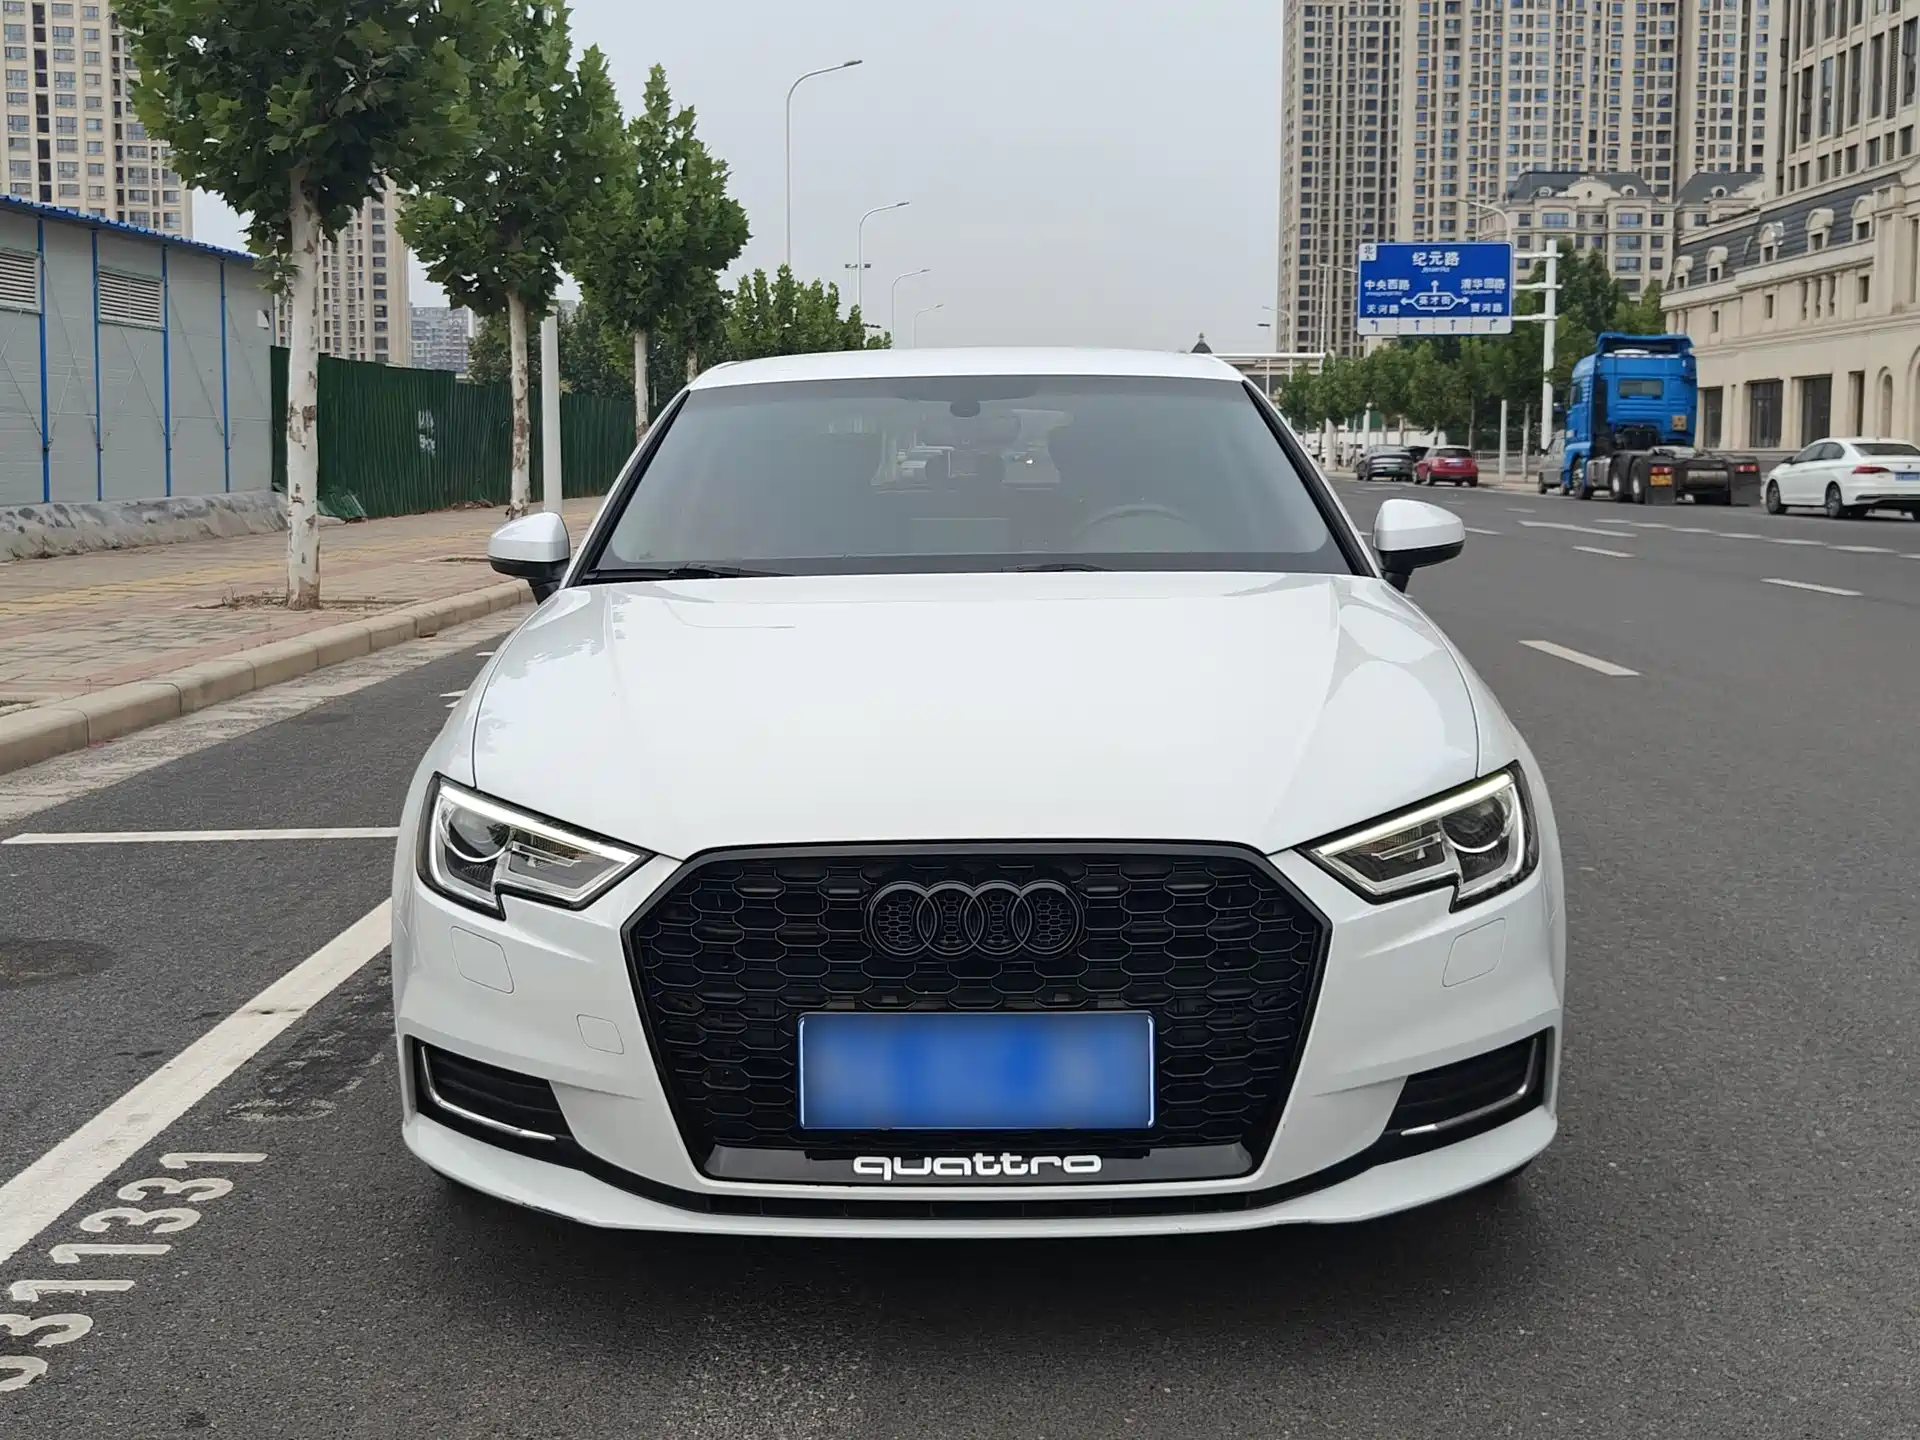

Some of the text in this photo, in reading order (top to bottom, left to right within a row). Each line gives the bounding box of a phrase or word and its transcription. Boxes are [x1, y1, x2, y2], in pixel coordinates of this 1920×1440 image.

[1412, 251, 1460, 266] 纪元路
[1364, 279, 1410, 291] 中央西路
[1418, 296, 1451, 305] 英才街
[1366, 304, 1399, 314] 天河路
[853, 1152, 1102, 1181] quattro
